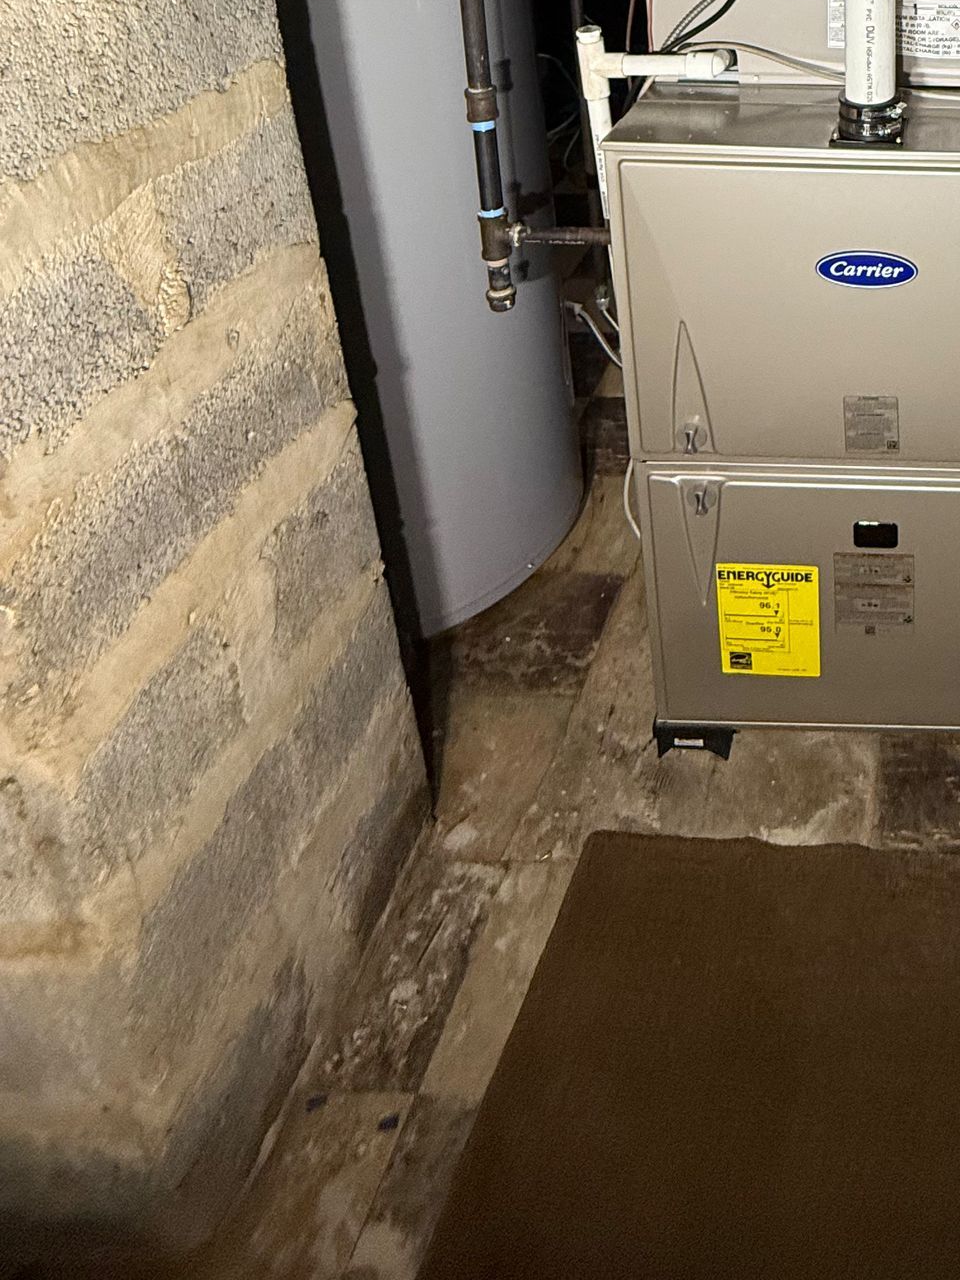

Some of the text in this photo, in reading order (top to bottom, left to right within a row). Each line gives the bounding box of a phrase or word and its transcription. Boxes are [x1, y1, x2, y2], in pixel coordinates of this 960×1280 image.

[866, 25, 875, 45] DWV
[829, 261, 904, 278] Carrier
[718, 570, 813, 584] ENERGYGUIDE
